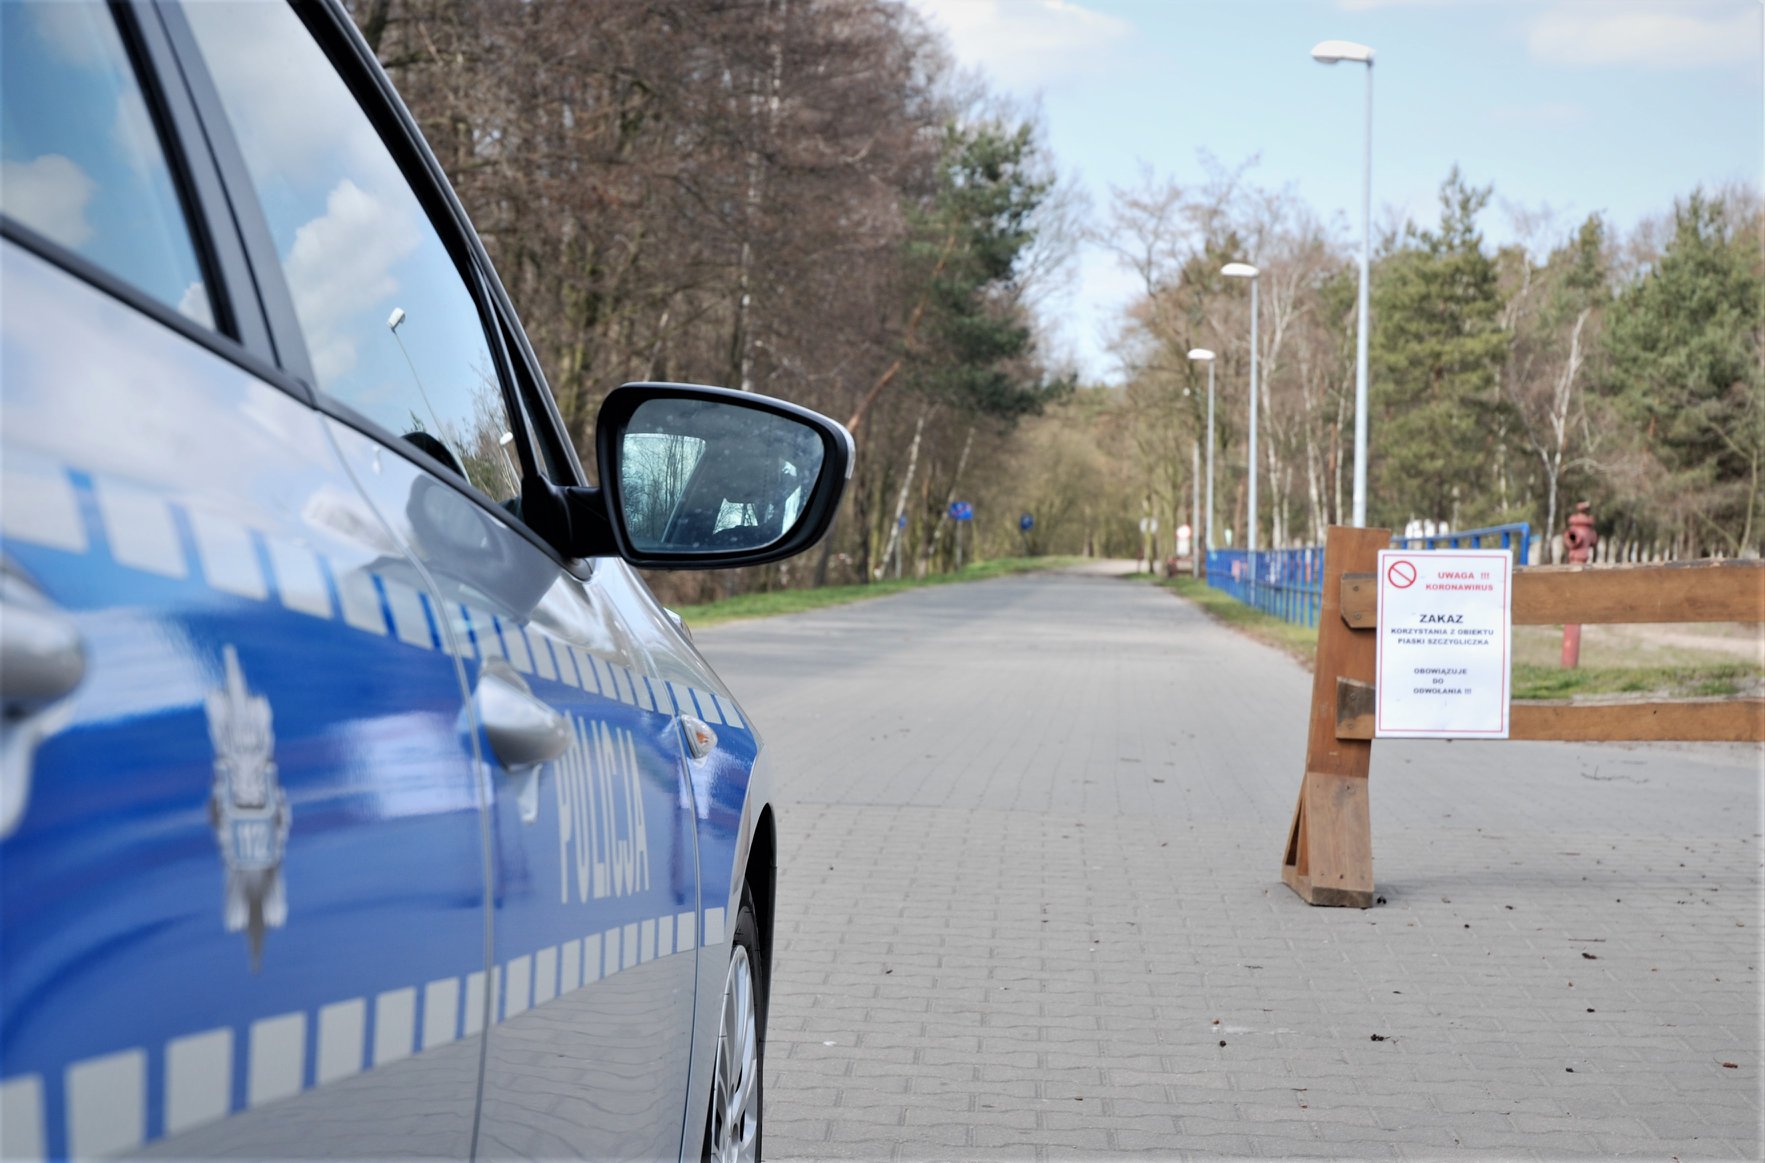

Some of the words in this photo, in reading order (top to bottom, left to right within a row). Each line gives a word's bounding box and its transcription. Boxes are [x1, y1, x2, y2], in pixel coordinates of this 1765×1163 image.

[1437, 572, 1475, 580] UWAGA
[1425, 583, 1494, 592] KORONAWIRUS
[1419, 614, 1464, 624] ZAKAZ
[1390, 627, 1448, 635] KORZYSTANIA
[1457, 628, 1494, 636] OBIEKTU
[1397, 637, 1425, 645] PIASKI
[1427, 638, 1489, 646] SZCZYGLICZKA
[1413, 667, 1468, 676] OBOWIĄZUJE
[1432, 677, 1444, 685] DO
[553, 708, 650, 904] POLICJA
